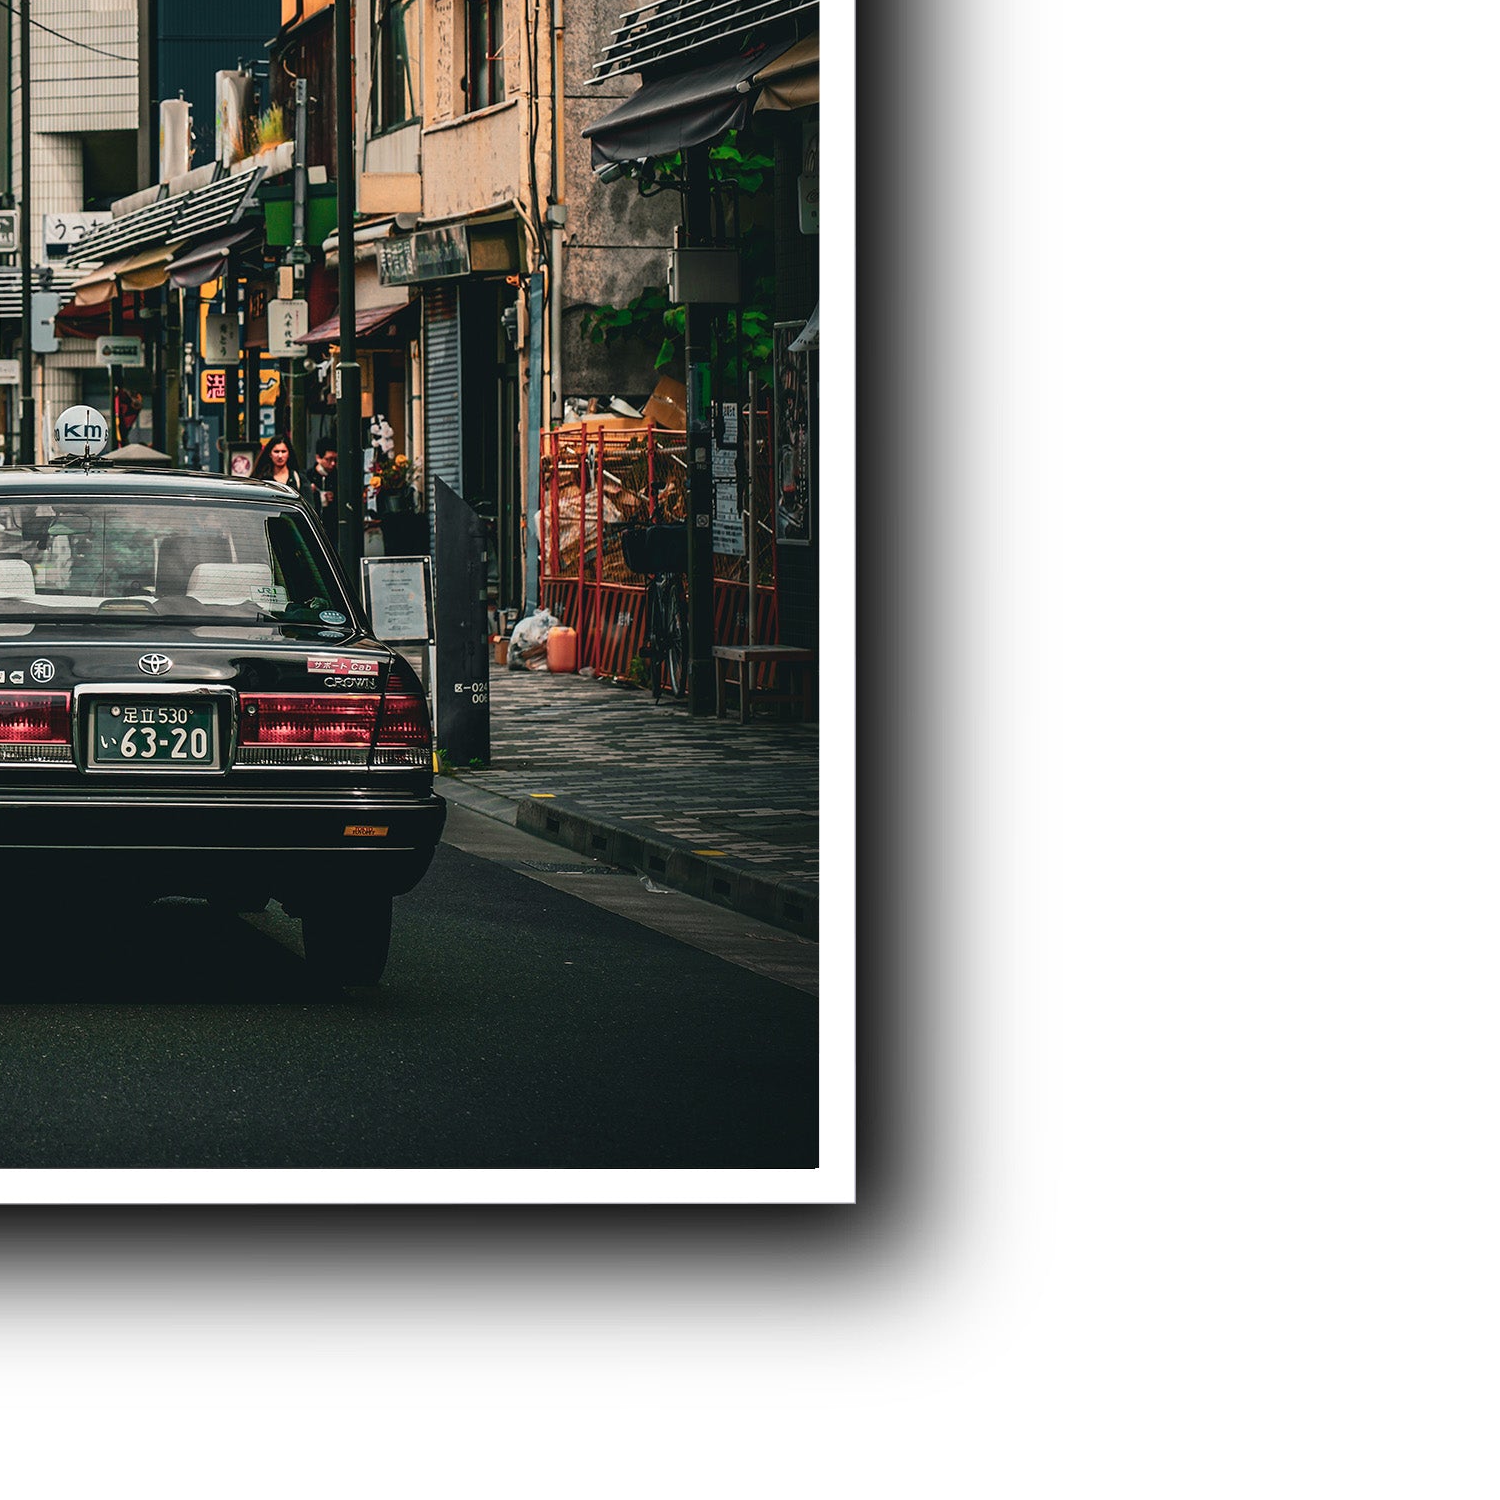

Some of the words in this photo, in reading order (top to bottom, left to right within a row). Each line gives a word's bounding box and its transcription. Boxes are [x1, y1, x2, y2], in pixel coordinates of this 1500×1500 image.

[33, 662, 52, 679] 和
[314, 661, 348, 670] サポート
[351, 663, 372, 671] Cab
[324, 677, 377, 690] CROWN
[123, 707, 156, 724] 足立
[158, 708, 188, 724] 530
[100, 735, 117, 749] い
[120, 726, 208, 759] 63-20
